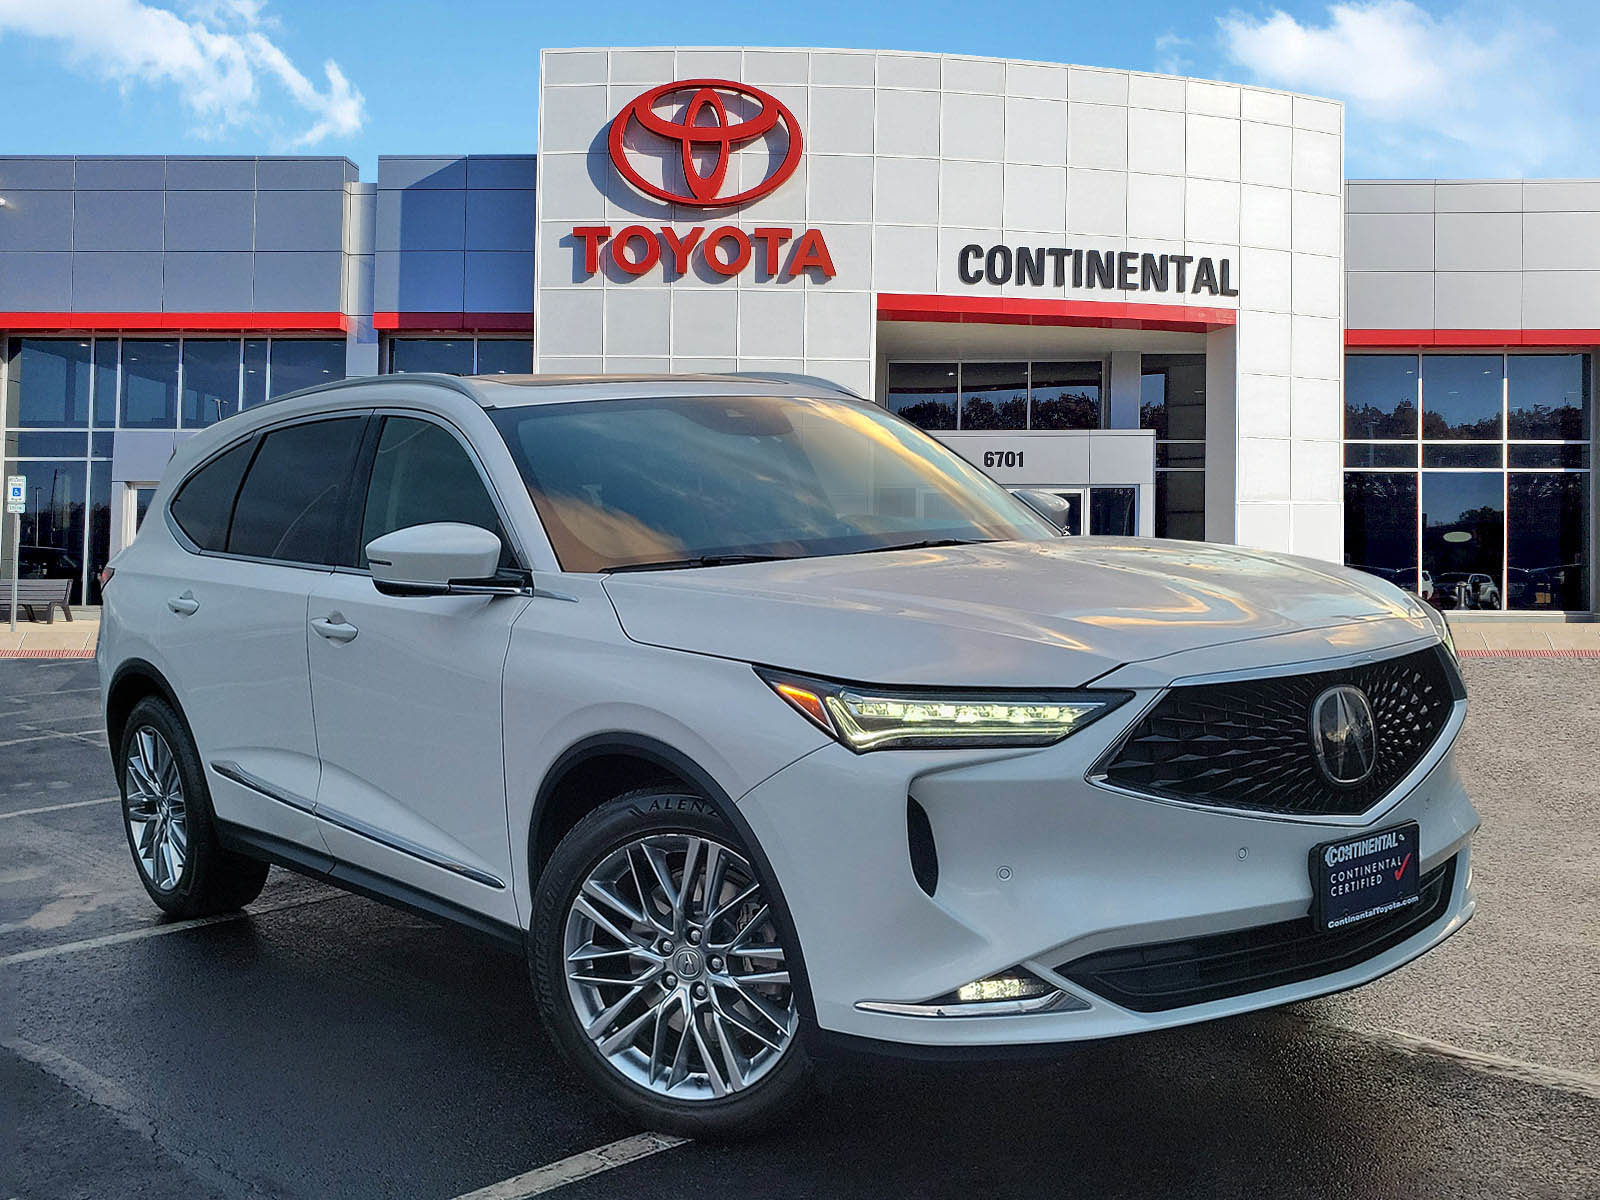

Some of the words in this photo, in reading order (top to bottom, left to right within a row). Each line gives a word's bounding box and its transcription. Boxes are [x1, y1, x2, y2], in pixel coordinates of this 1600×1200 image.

[572, 225, 837, 277] TOYOTA
[959, 244, 1239, 297] CONTINENTAL
[983, 451, 1024, 468] 6701
[1325, 832, 1398, 867] CONTINENTAL
[1330, 856, 1402, 884] CONTINENTAL
[1330, 874, 1383, 897] CERTIFIED
[1327, 895, 1419, 929] ContinentalToyota.com
